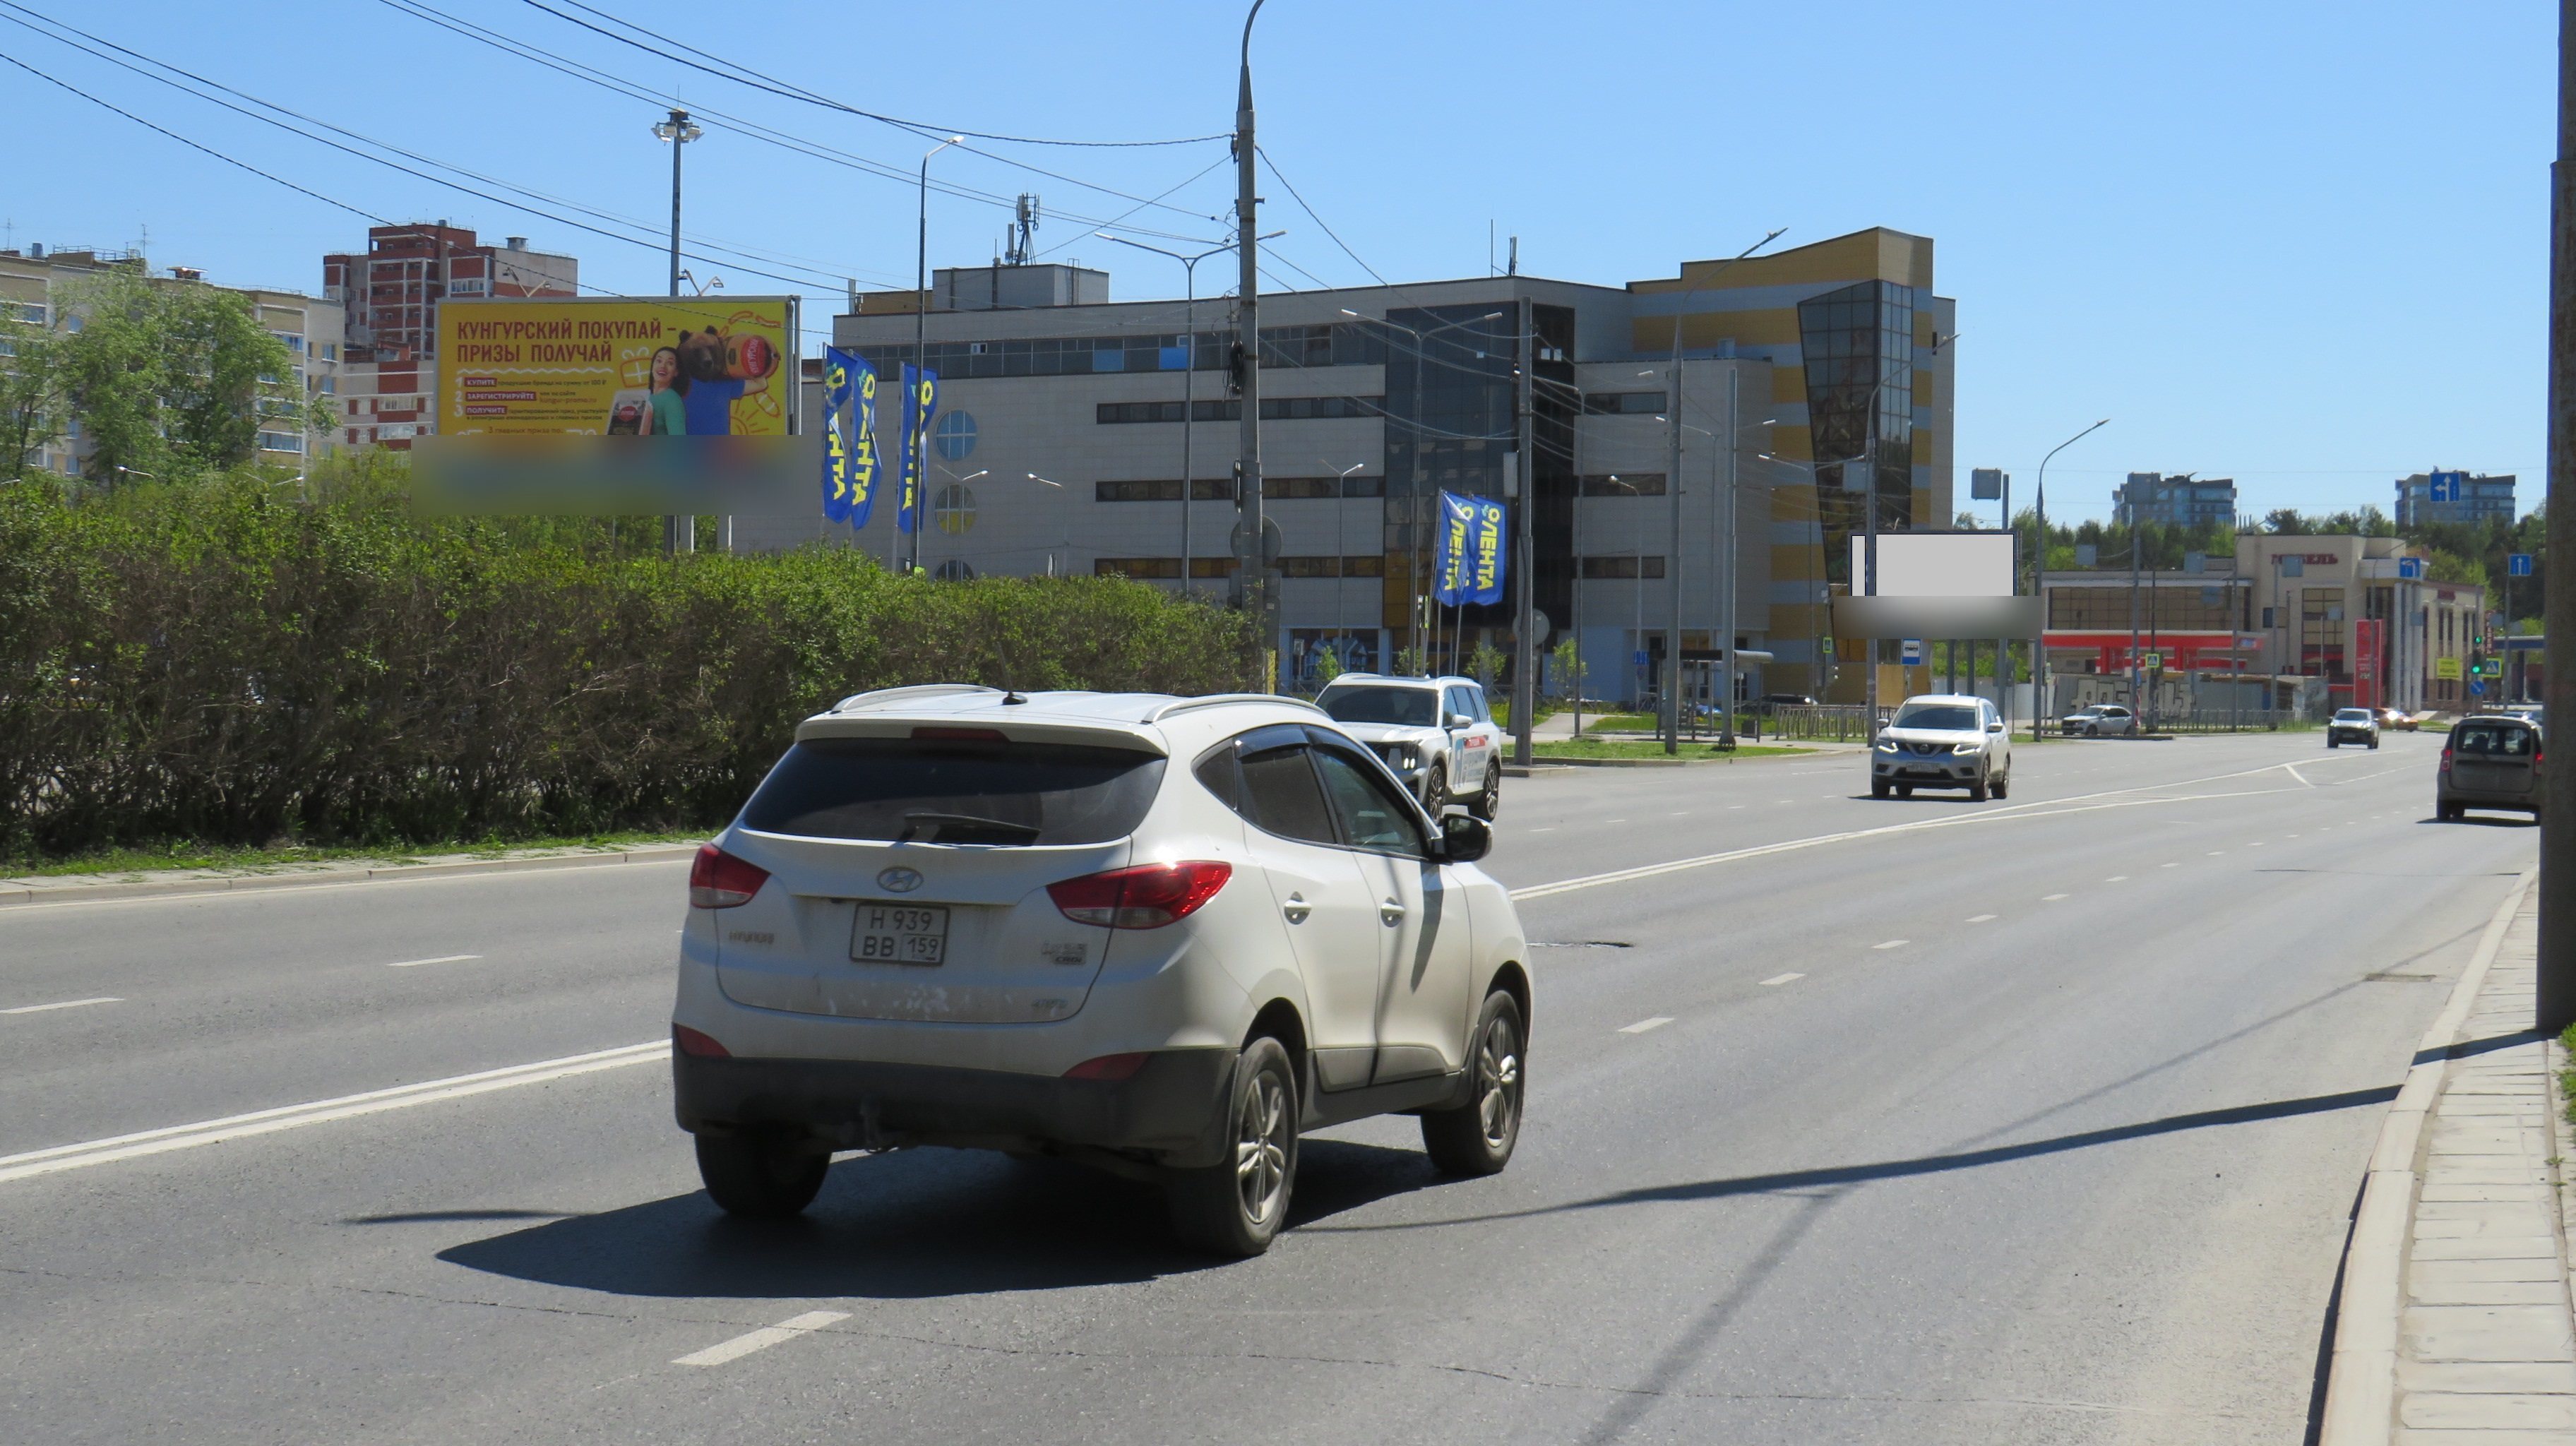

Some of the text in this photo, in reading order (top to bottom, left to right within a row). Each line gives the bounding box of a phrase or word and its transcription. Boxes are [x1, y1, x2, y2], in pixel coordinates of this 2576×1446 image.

[457, 318, 572, 340] КУНГУРСКИЙ
[578, 318, 661, 340] ПОКУПАЙ
[457, 340, 612, 363] ПРИЗЫ ПОЛУЧАЙ
[455, 377, 463, 388] 1
[455, 390, 463, 402] 2
[454, 404, 464, 417] 3
[1477, 520, 1498, 590] ЛЕНТА
[893, 909, 933, 931] 939
[907, 937, 938, 954] 159
